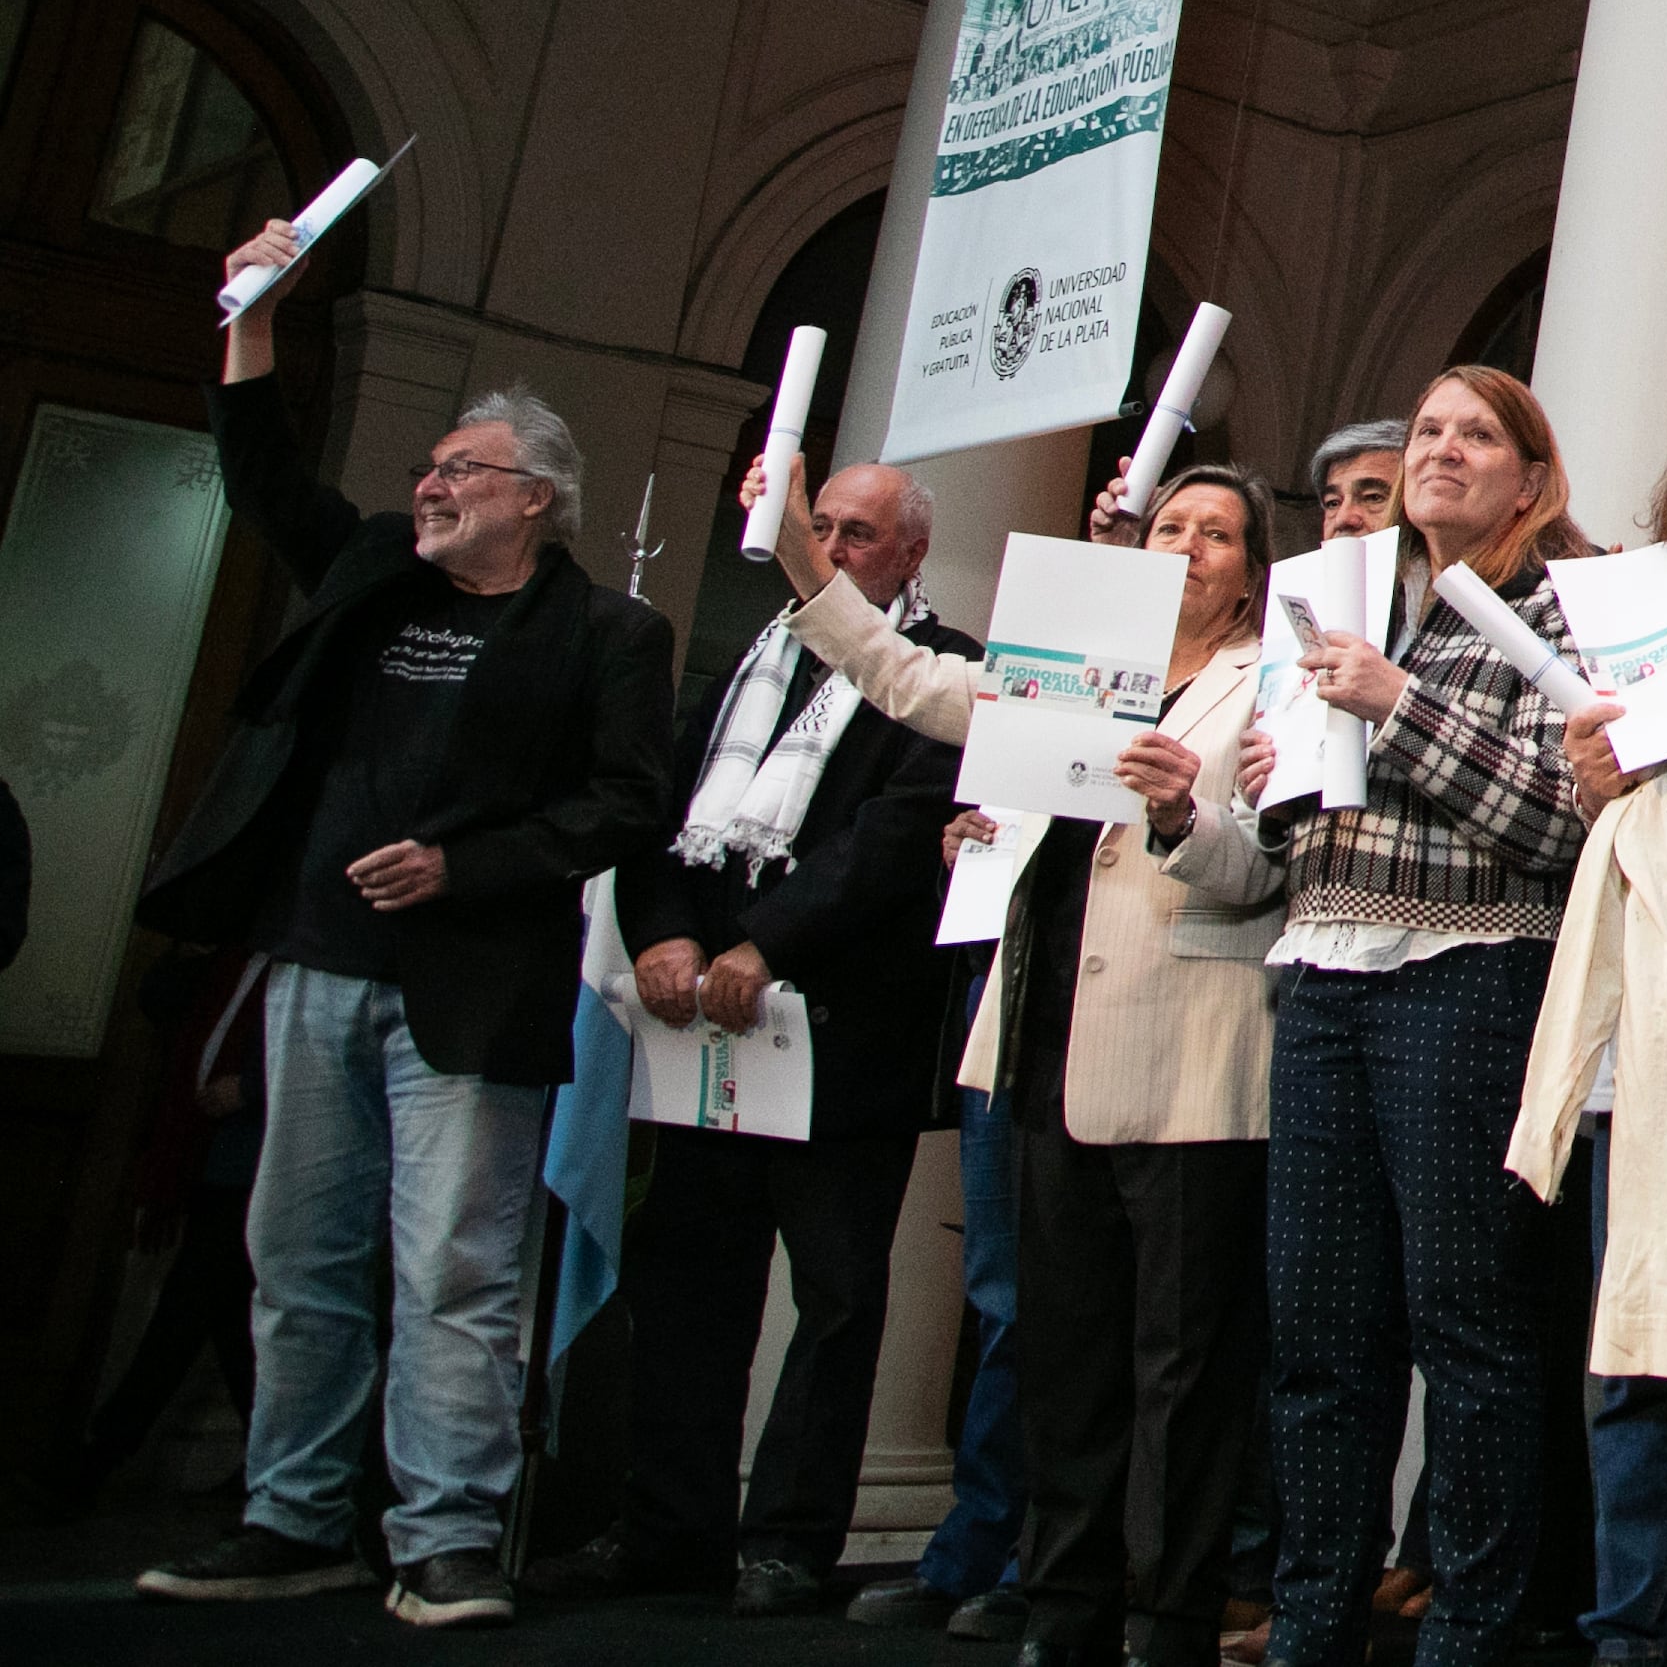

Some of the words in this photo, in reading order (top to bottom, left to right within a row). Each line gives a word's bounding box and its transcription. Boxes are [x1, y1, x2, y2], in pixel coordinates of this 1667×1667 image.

[944, 114, 963, 144] EN
[1023, 85, 1038, 124] LA
[1042, 54, 1121, 119] EDUCACIÓN
[1049, 262, 1127, 299] UNIVERSIDAD
[931, 302, 979, 330] EDUCACIÓN
[1044, 295, 1103, 327] NACIONAL
[939, 328, 973, 350] PÚBLICA
[1039, 333, 1055, 353] DE
[1057, 329, 1071, 349] LA
[1074, 319, 1110, 345] PLATA
[922, 364, 929, 378] Y
[929, 353, 970, 377] GRATUITA
[1005, 665, 1080, 684] HONORIS
[1041, 680, 1095, 697] CAUSA
